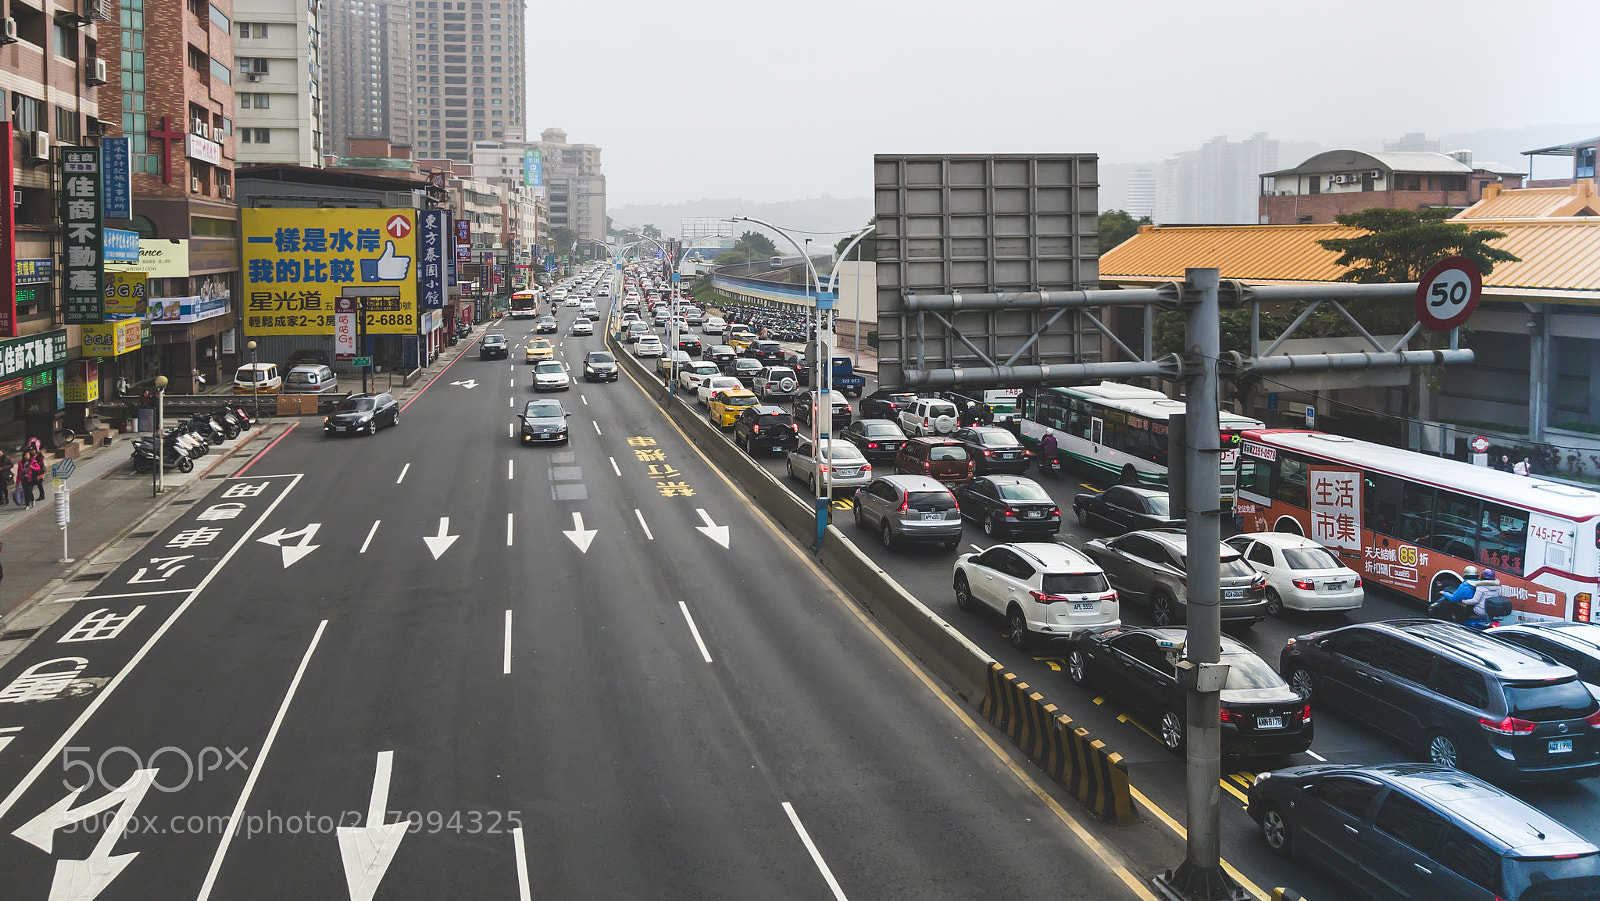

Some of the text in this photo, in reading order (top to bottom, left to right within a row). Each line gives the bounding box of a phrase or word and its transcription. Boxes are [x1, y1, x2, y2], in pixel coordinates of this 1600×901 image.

[68, 153, 93, 162] 住商
[67, 176, 97, 291] 住商不動產
[248, 227, 381, 253] 一樣是水岸
[248, 258, 355, 284] 我的比較
[425, 214, 441, 305] 東方泰國小館
[248, 290, 322, 312] 星光道
[1430, 281, 1467, 307] 50
[5, 337, 54, 376] 住商不動產
[626, 436, 697, 498] 禁行機車
[1315, 476, 1356, 509] 生活
[127, 480, 271, 585] 公車專用
[1315, 511, 1358, 543] 市集
[1530, 524, 1564, 545] 745-FZ
[1400, 547, 1416, 564] 85
[1419, 552, 1429, 566] 折
